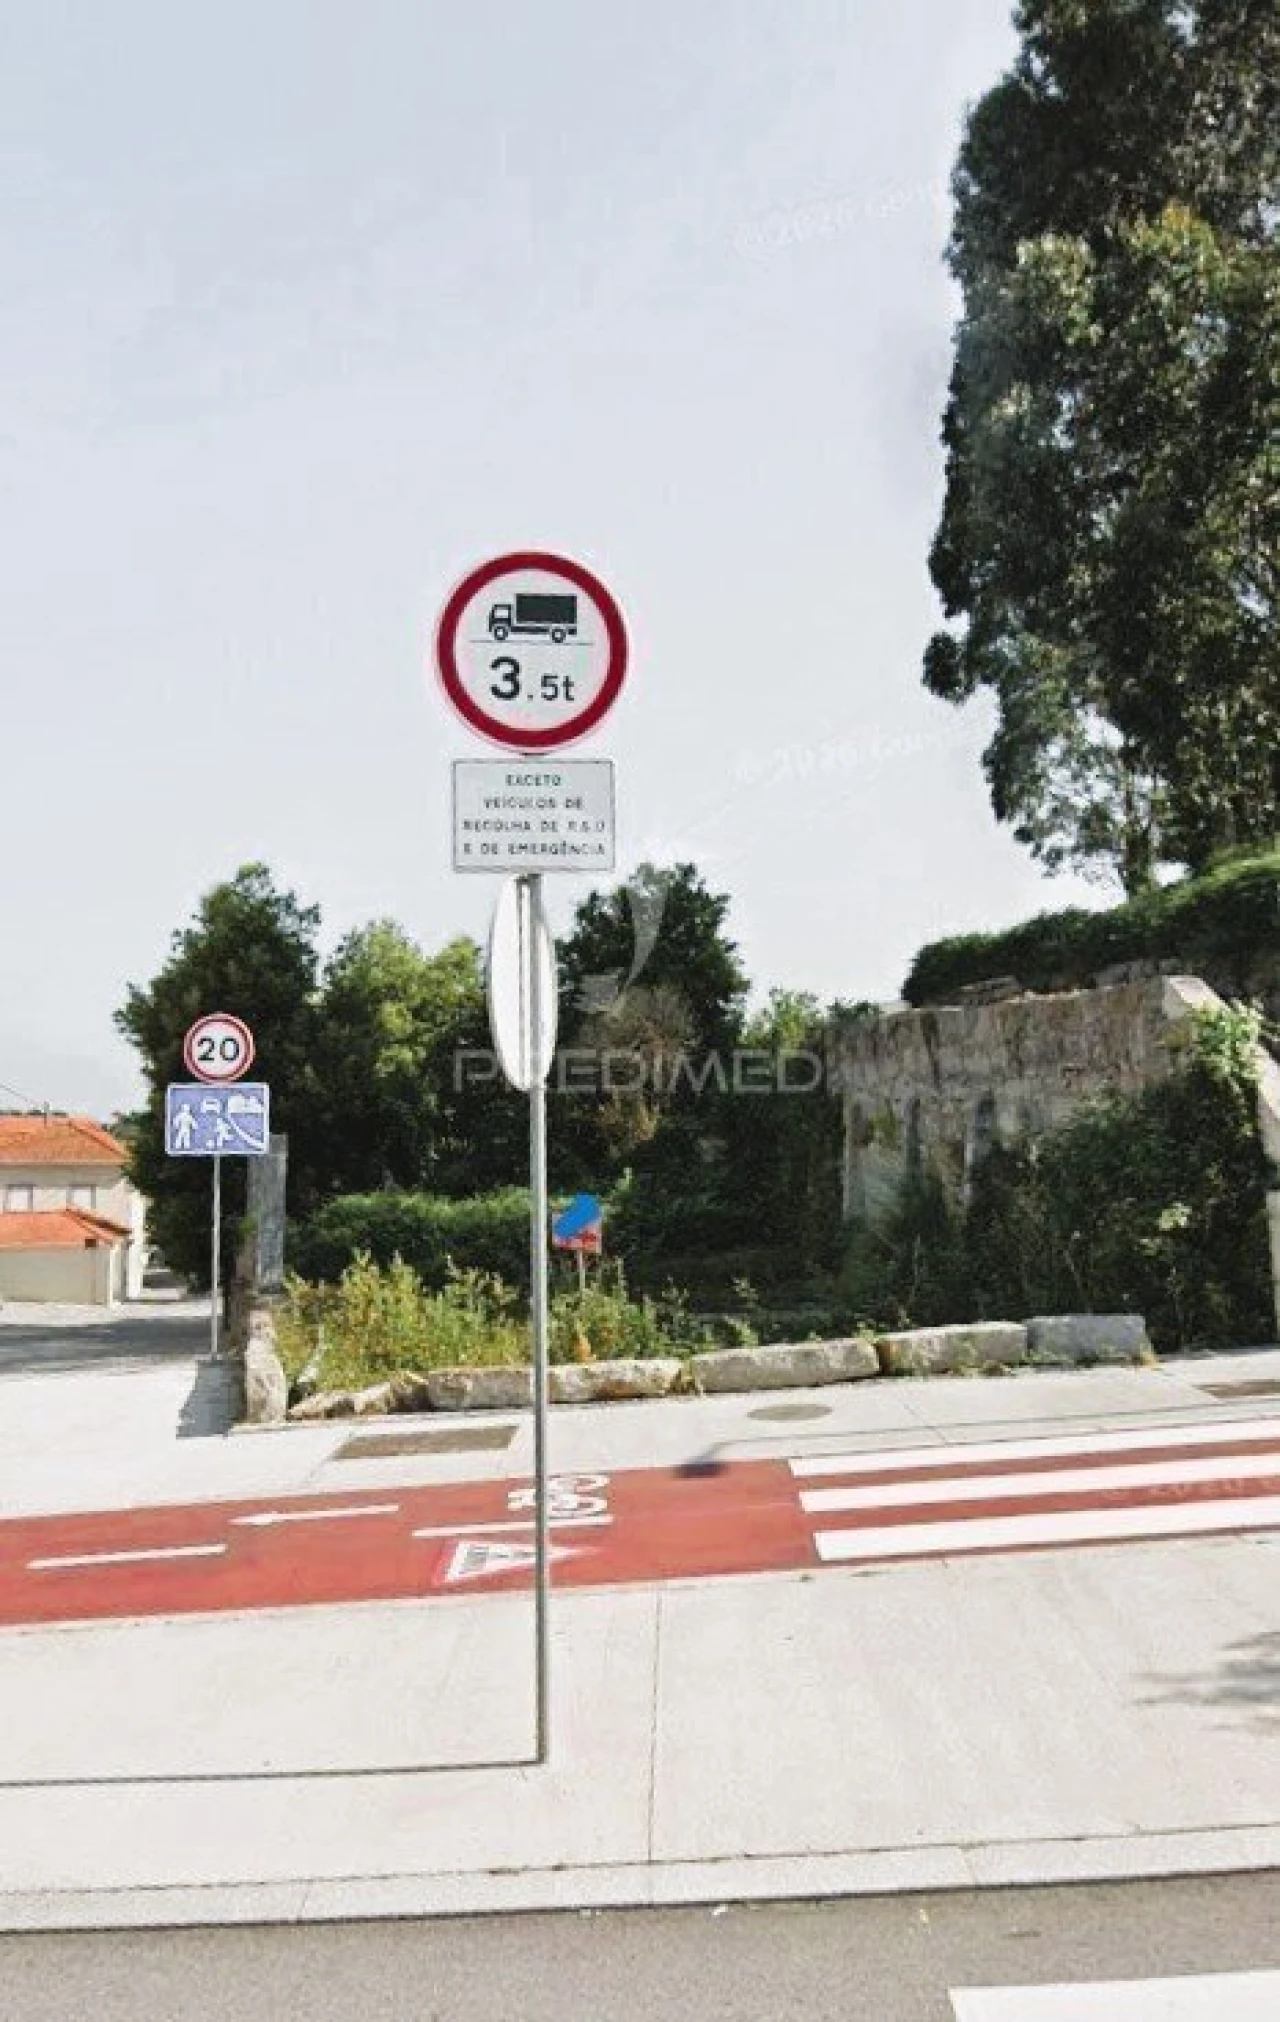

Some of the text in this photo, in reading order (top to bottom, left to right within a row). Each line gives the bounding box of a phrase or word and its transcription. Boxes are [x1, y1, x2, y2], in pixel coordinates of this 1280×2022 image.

[505, 773, 562, 787] EXCETO
[565, 796, 583, 809] DE
[462, 819, 531, 832] RECOLHA
[540, 819, 558, 833] DE
[463, 840, 606, 856] E DE EMERGÊNCIA
[197, 1037, 240, 1061] 20
